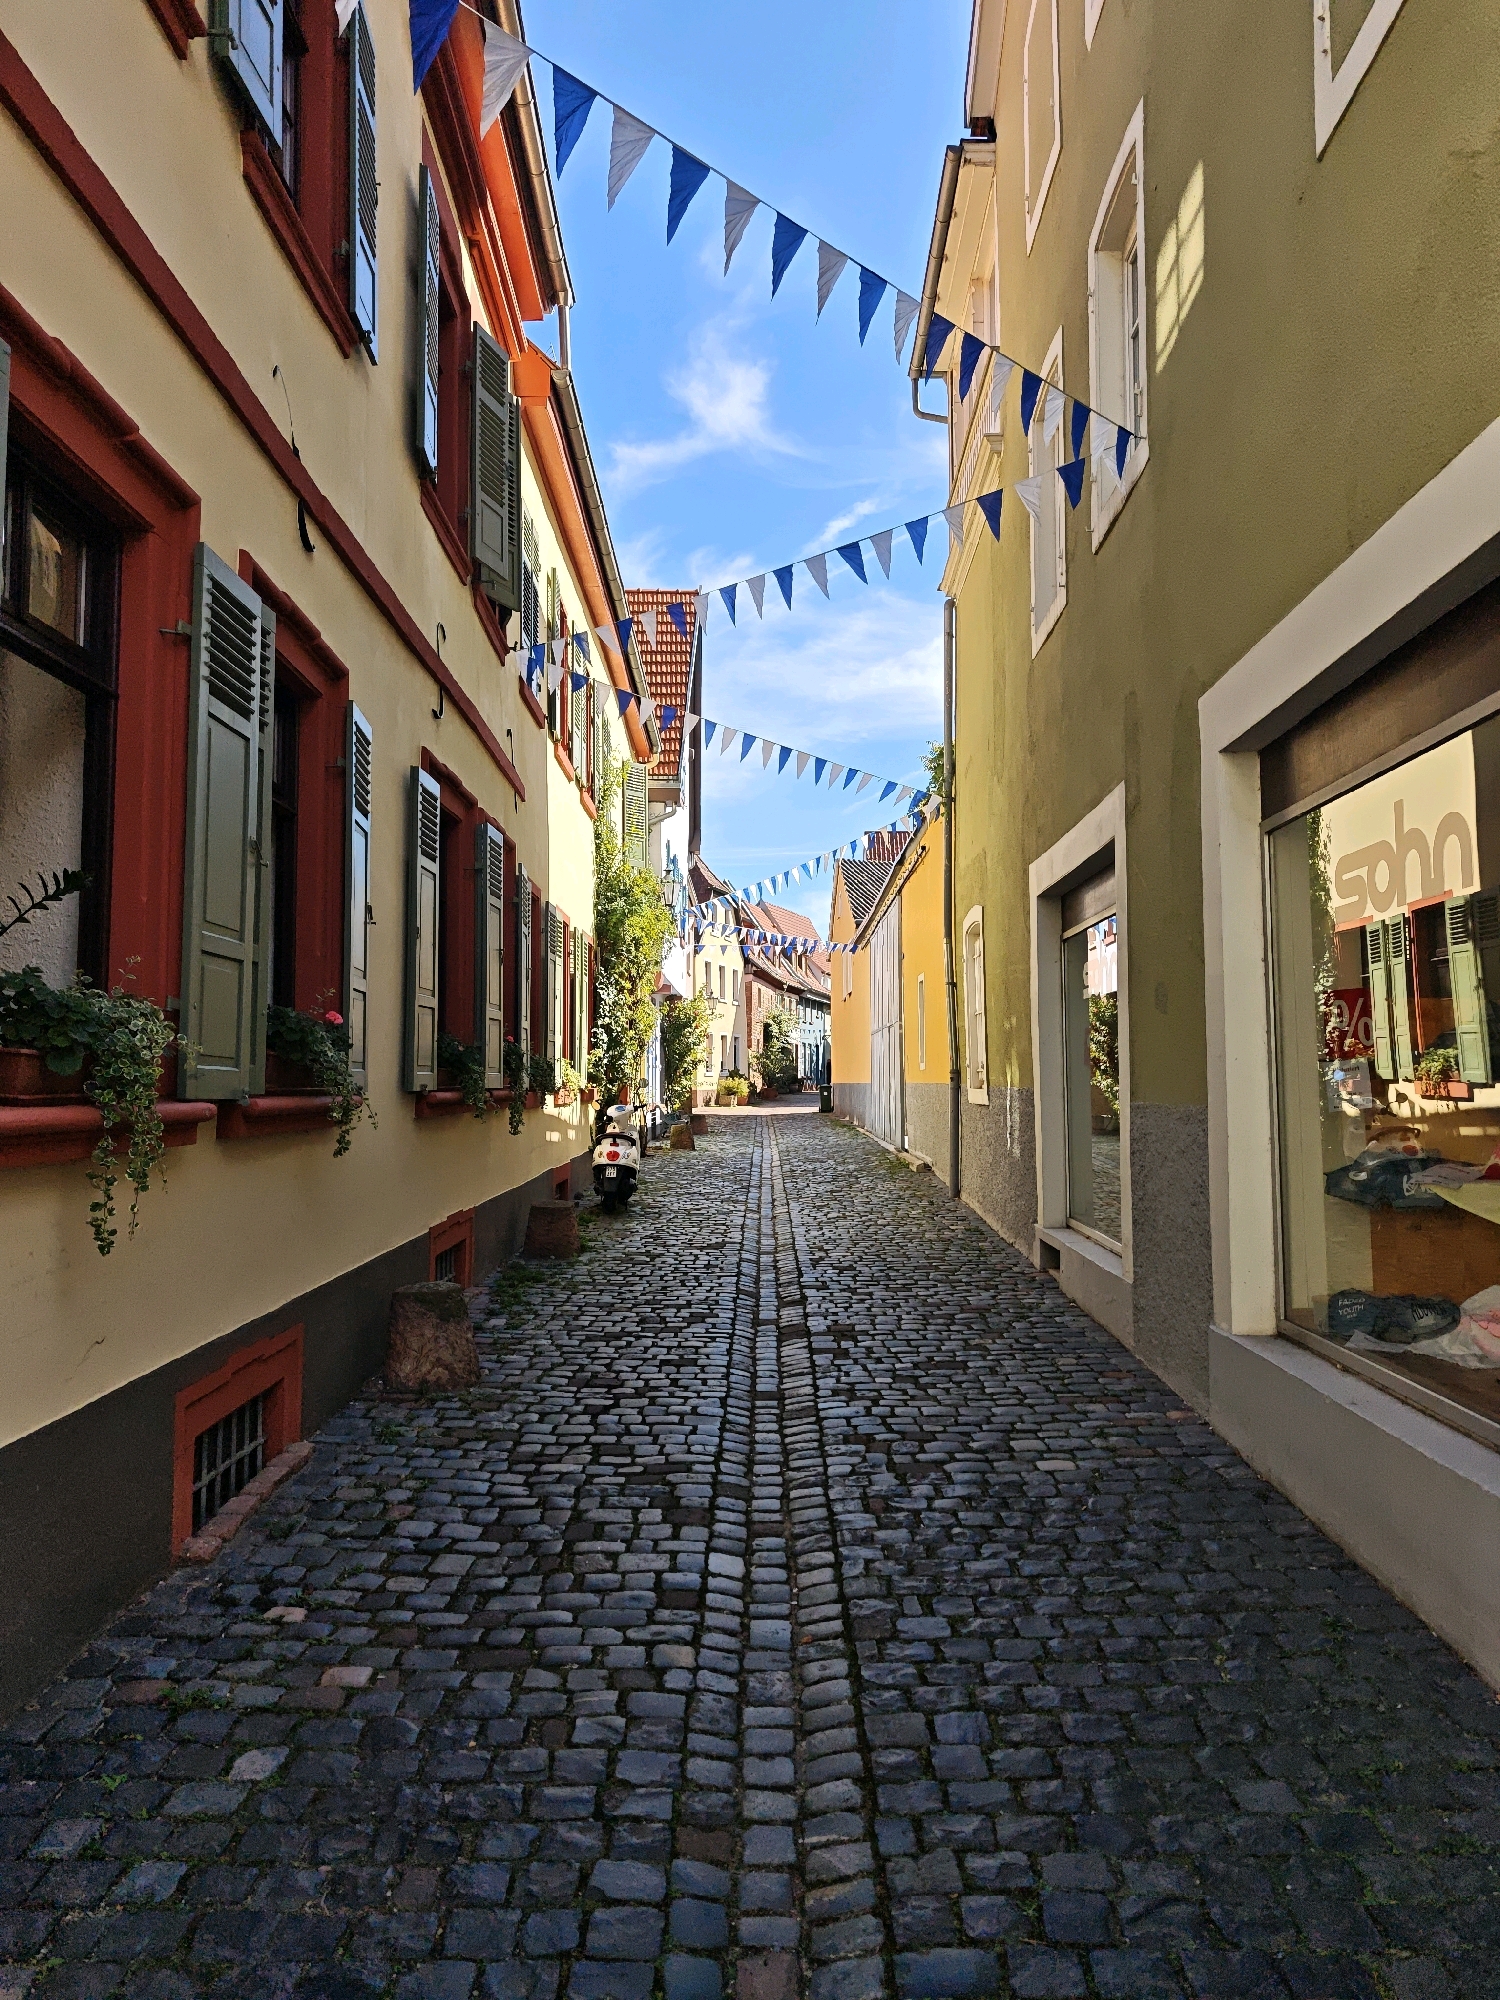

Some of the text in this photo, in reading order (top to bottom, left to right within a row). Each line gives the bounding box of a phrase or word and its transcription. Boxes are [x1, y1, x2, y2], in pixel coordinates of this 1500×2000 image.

[1335, 799, 1473, 922] sohn
[1332, 998, 1374, 1049] %
[1338, 1303, 1364, 1316] YOUTH
